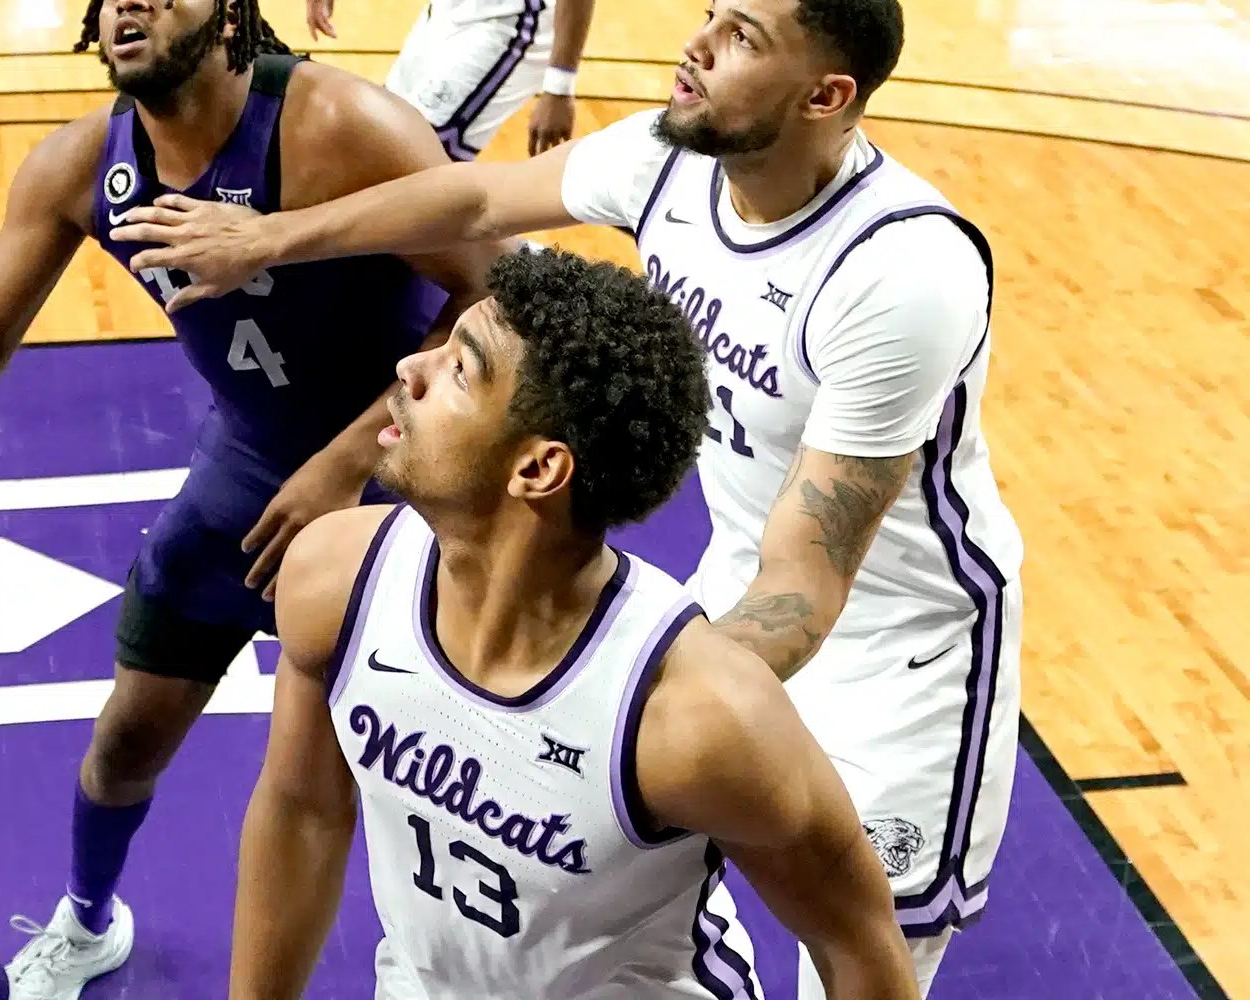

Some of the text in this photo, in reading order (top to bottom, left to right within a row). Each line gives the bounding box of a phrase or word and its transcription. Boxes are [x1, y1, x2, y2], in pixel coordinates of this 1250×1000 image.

[760, 281, 793, 313] XII
[227, 318, 291, 389] 4
[703, 385, 754, 459] 1
[350, 704, 593, 874] Wildcats
[535, 732, 591, 780] XII
[407, 813, 520, 938] 13
